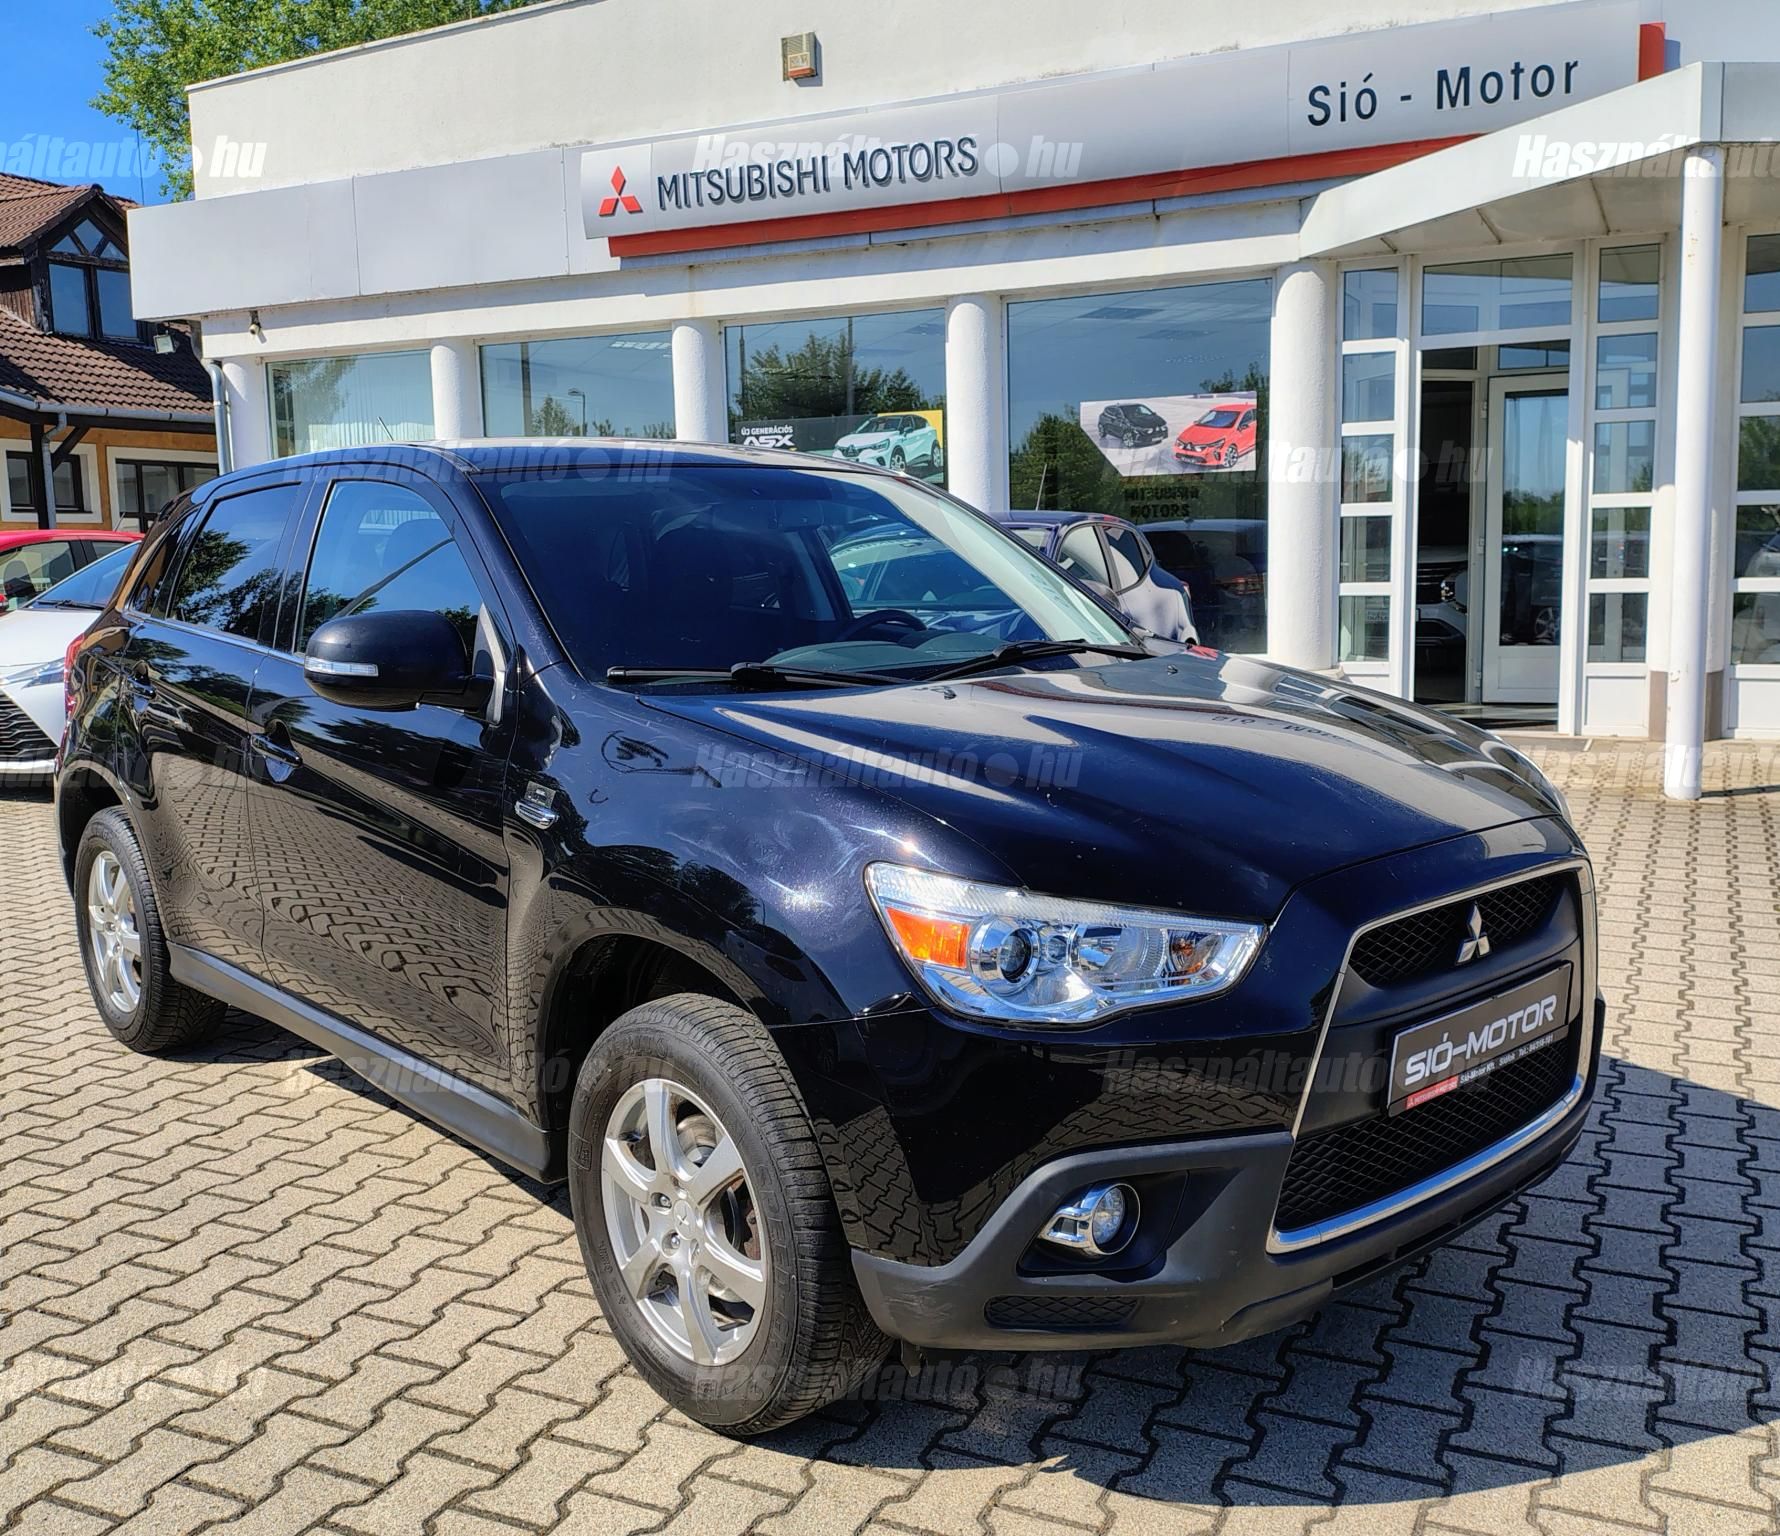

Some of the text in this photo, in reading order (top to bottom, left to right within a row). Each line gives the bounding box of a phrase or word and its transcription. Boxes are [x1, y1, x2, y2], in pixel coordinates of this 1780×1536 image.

[1307, 72, 1377, 127] Sió
[1436, 60, 1579, 110] Motor
[656, 136, 979, 211] MITSUBISHI MOTORS
[743, 434, 796, 448] ASX
[1404, 994, 1558, 1087] SIÓ-MOTOR
